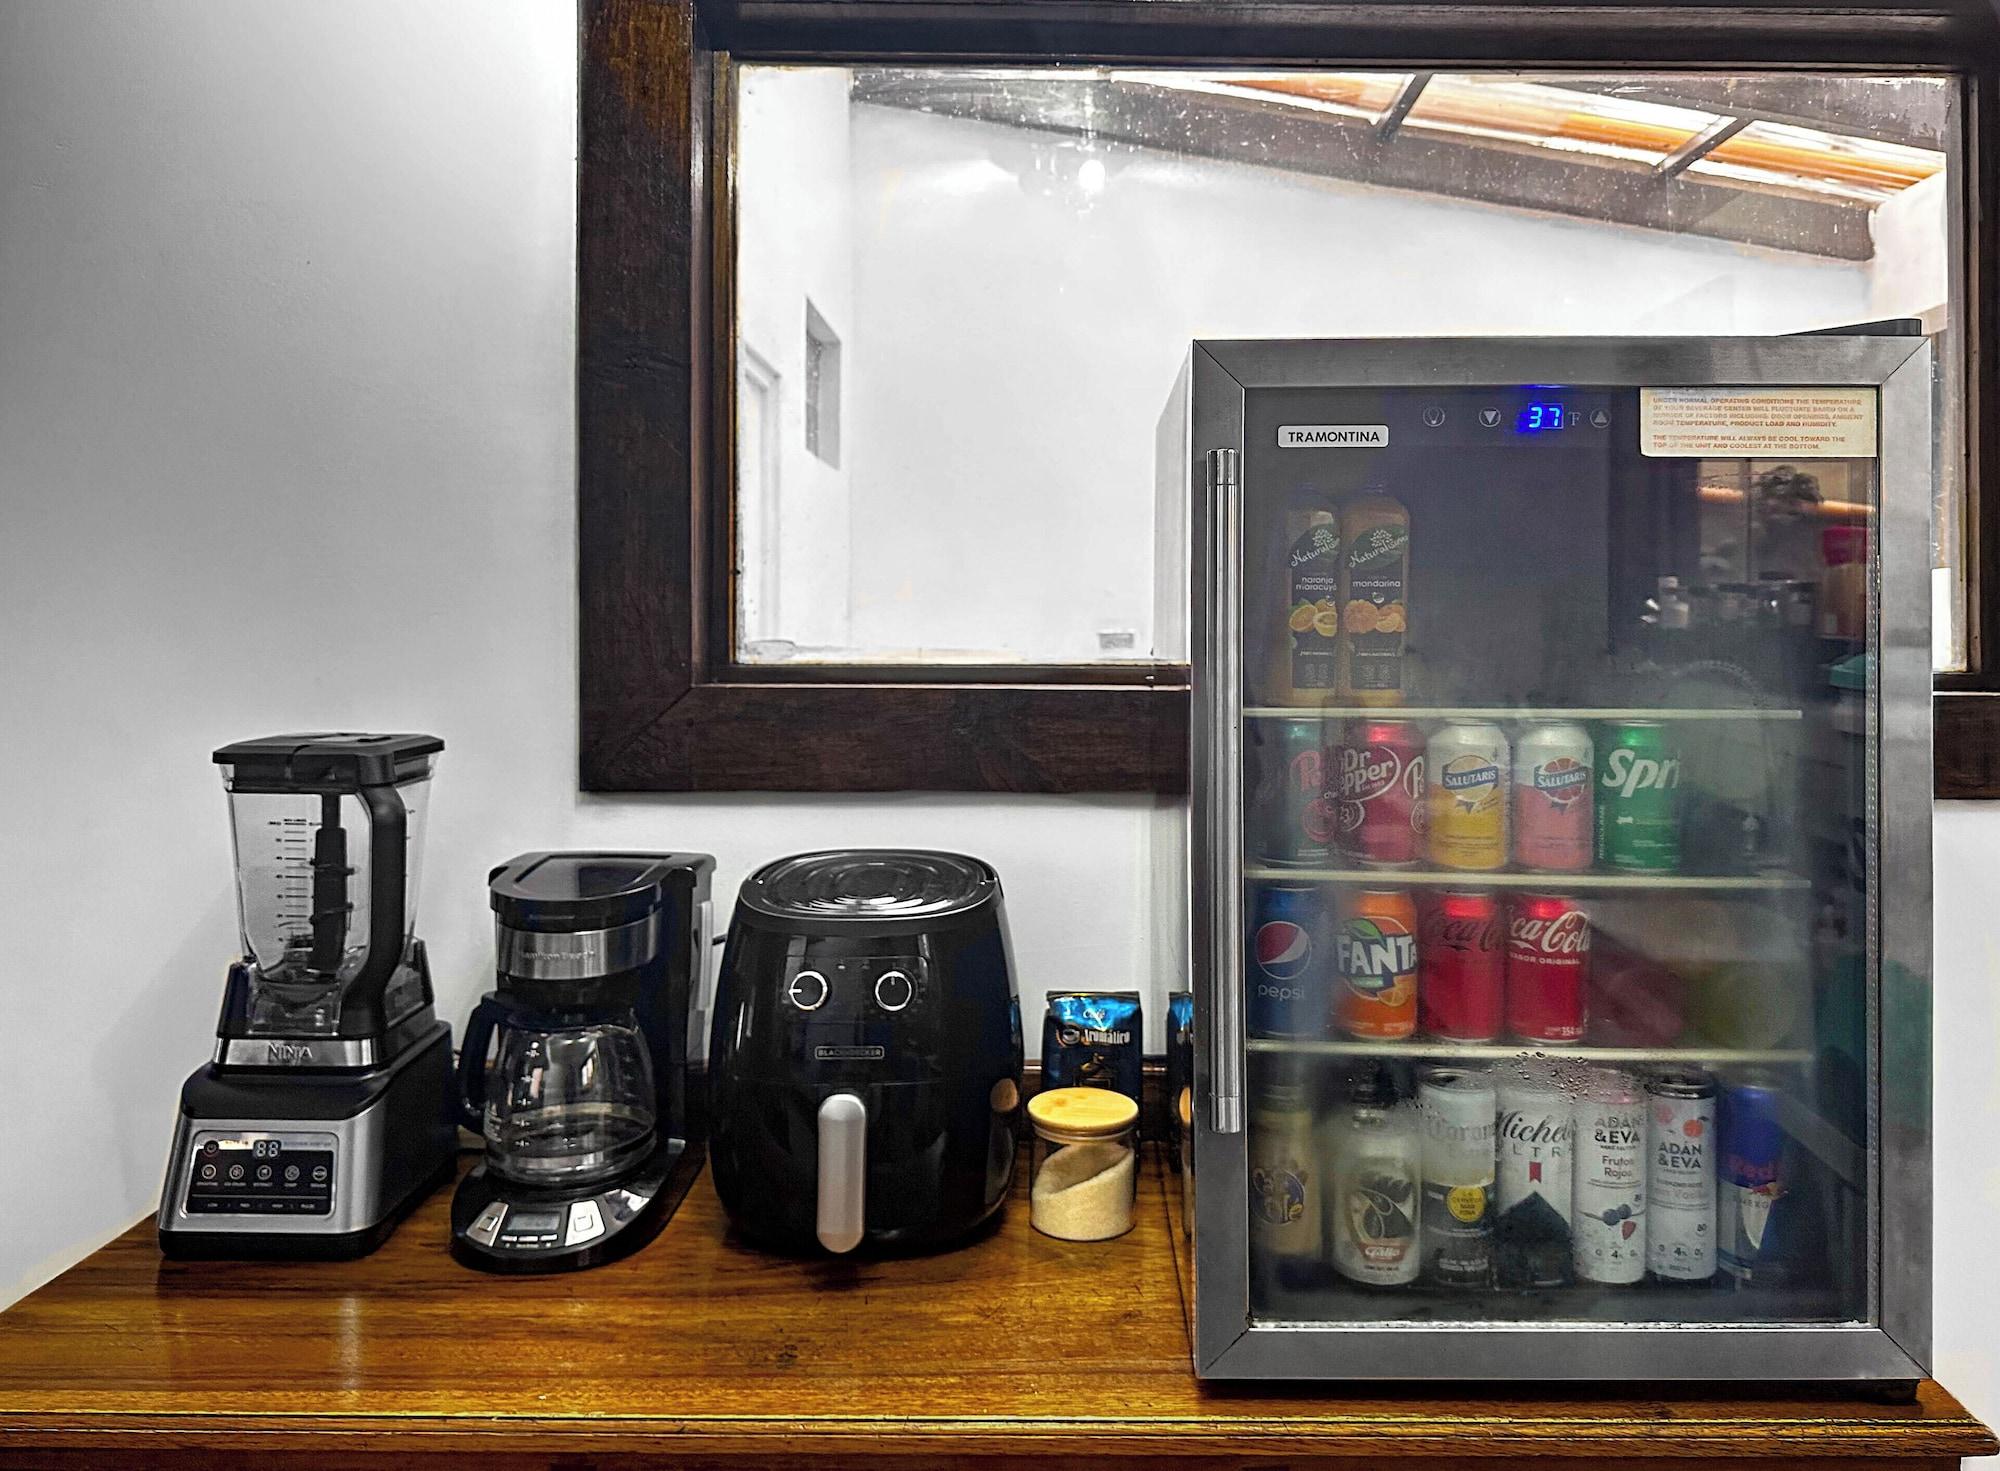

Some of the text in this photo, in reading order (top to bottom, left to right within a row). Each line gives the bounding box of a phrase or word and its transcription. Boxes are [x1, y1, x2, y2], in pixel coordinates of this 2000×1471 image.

[1527, 406, 1561, 429] 37
[1288, 431, 1380, 443] TRAMONTINA
[1352, 579, 1401, 588] mandarina
[1444, 769, 1497, 788] SALUTARIS
[1536, 771, 1587, 788] SALUTARIS
[1257, 984, 1305, 1001] pepsi
[267, 1042, 313, 1066] NINJA
